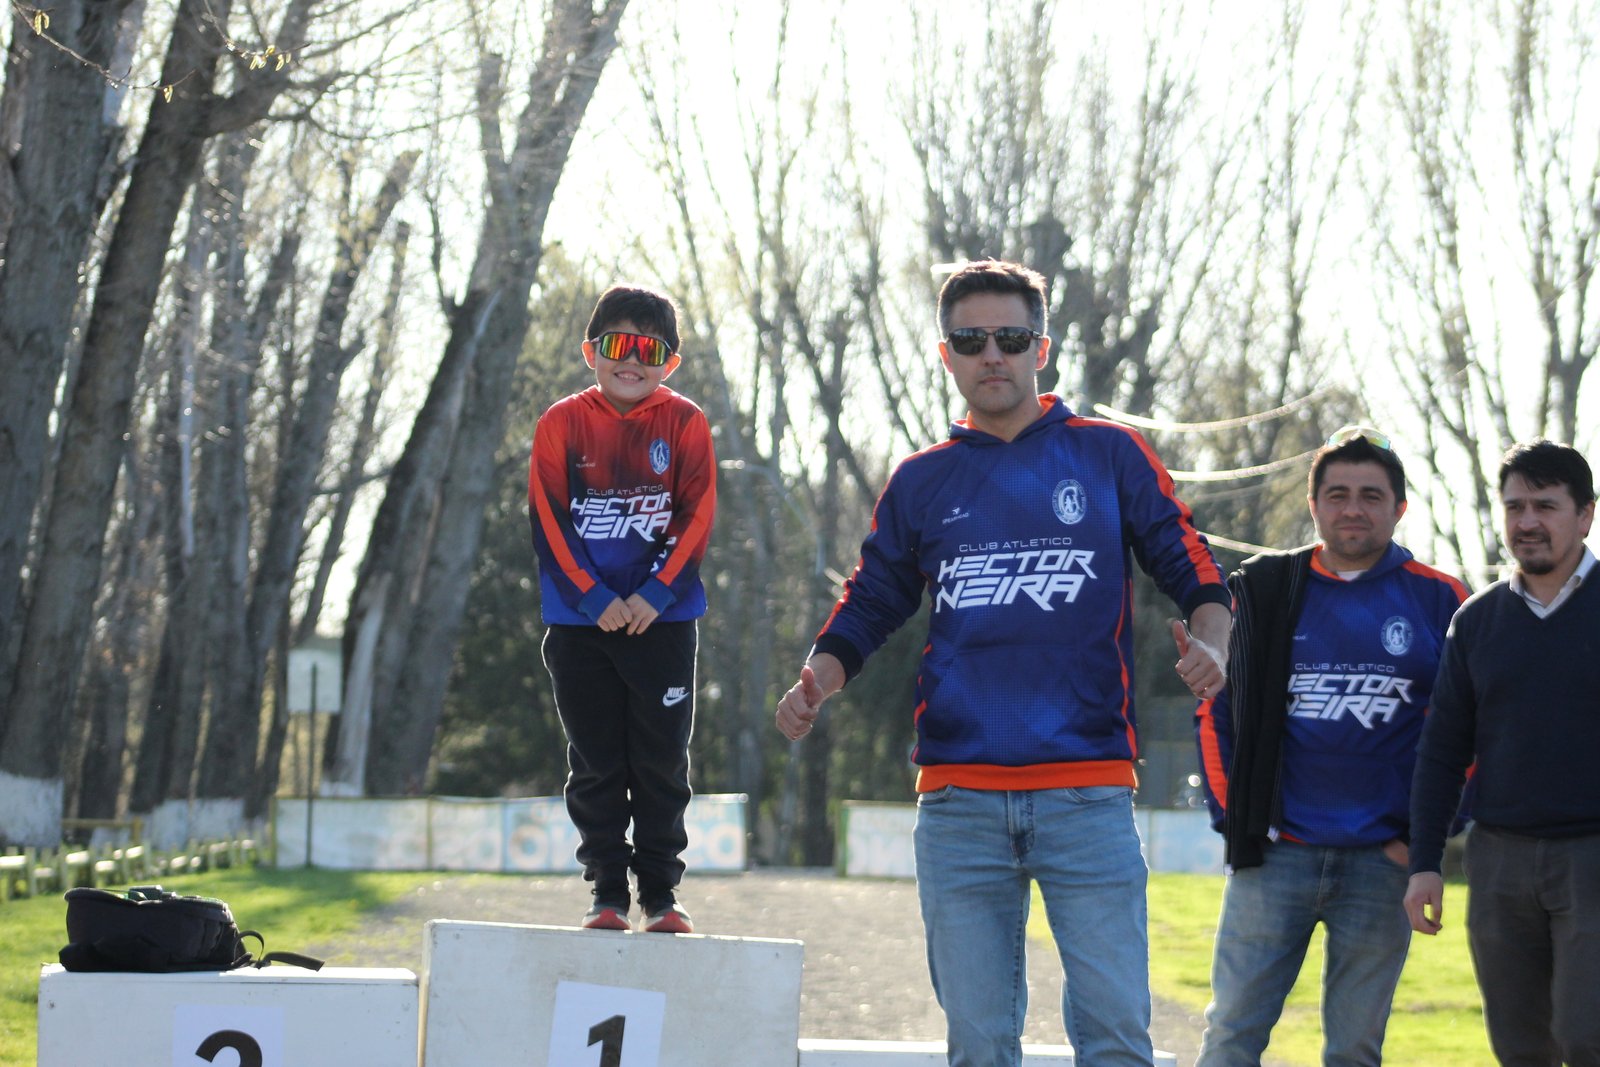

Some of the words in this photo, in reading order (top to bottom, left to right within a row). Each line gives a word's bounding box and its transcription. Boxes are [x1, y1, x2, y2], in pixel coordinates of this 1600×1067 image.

[586, 488, 614, 496] CLUB
[617, 484, 664, 496] ATLETICO
[958, 543, 998, 553] CLUB
[1002, 537, 1073, 550] ATLETICO
[937, 549, 1098, 583] HECTOR
[935, 573, 1087, 614] NEIRA
[1295, 663, 1330, 671] CLUB
[1333, 663, 1395, 673] ATLETICO
